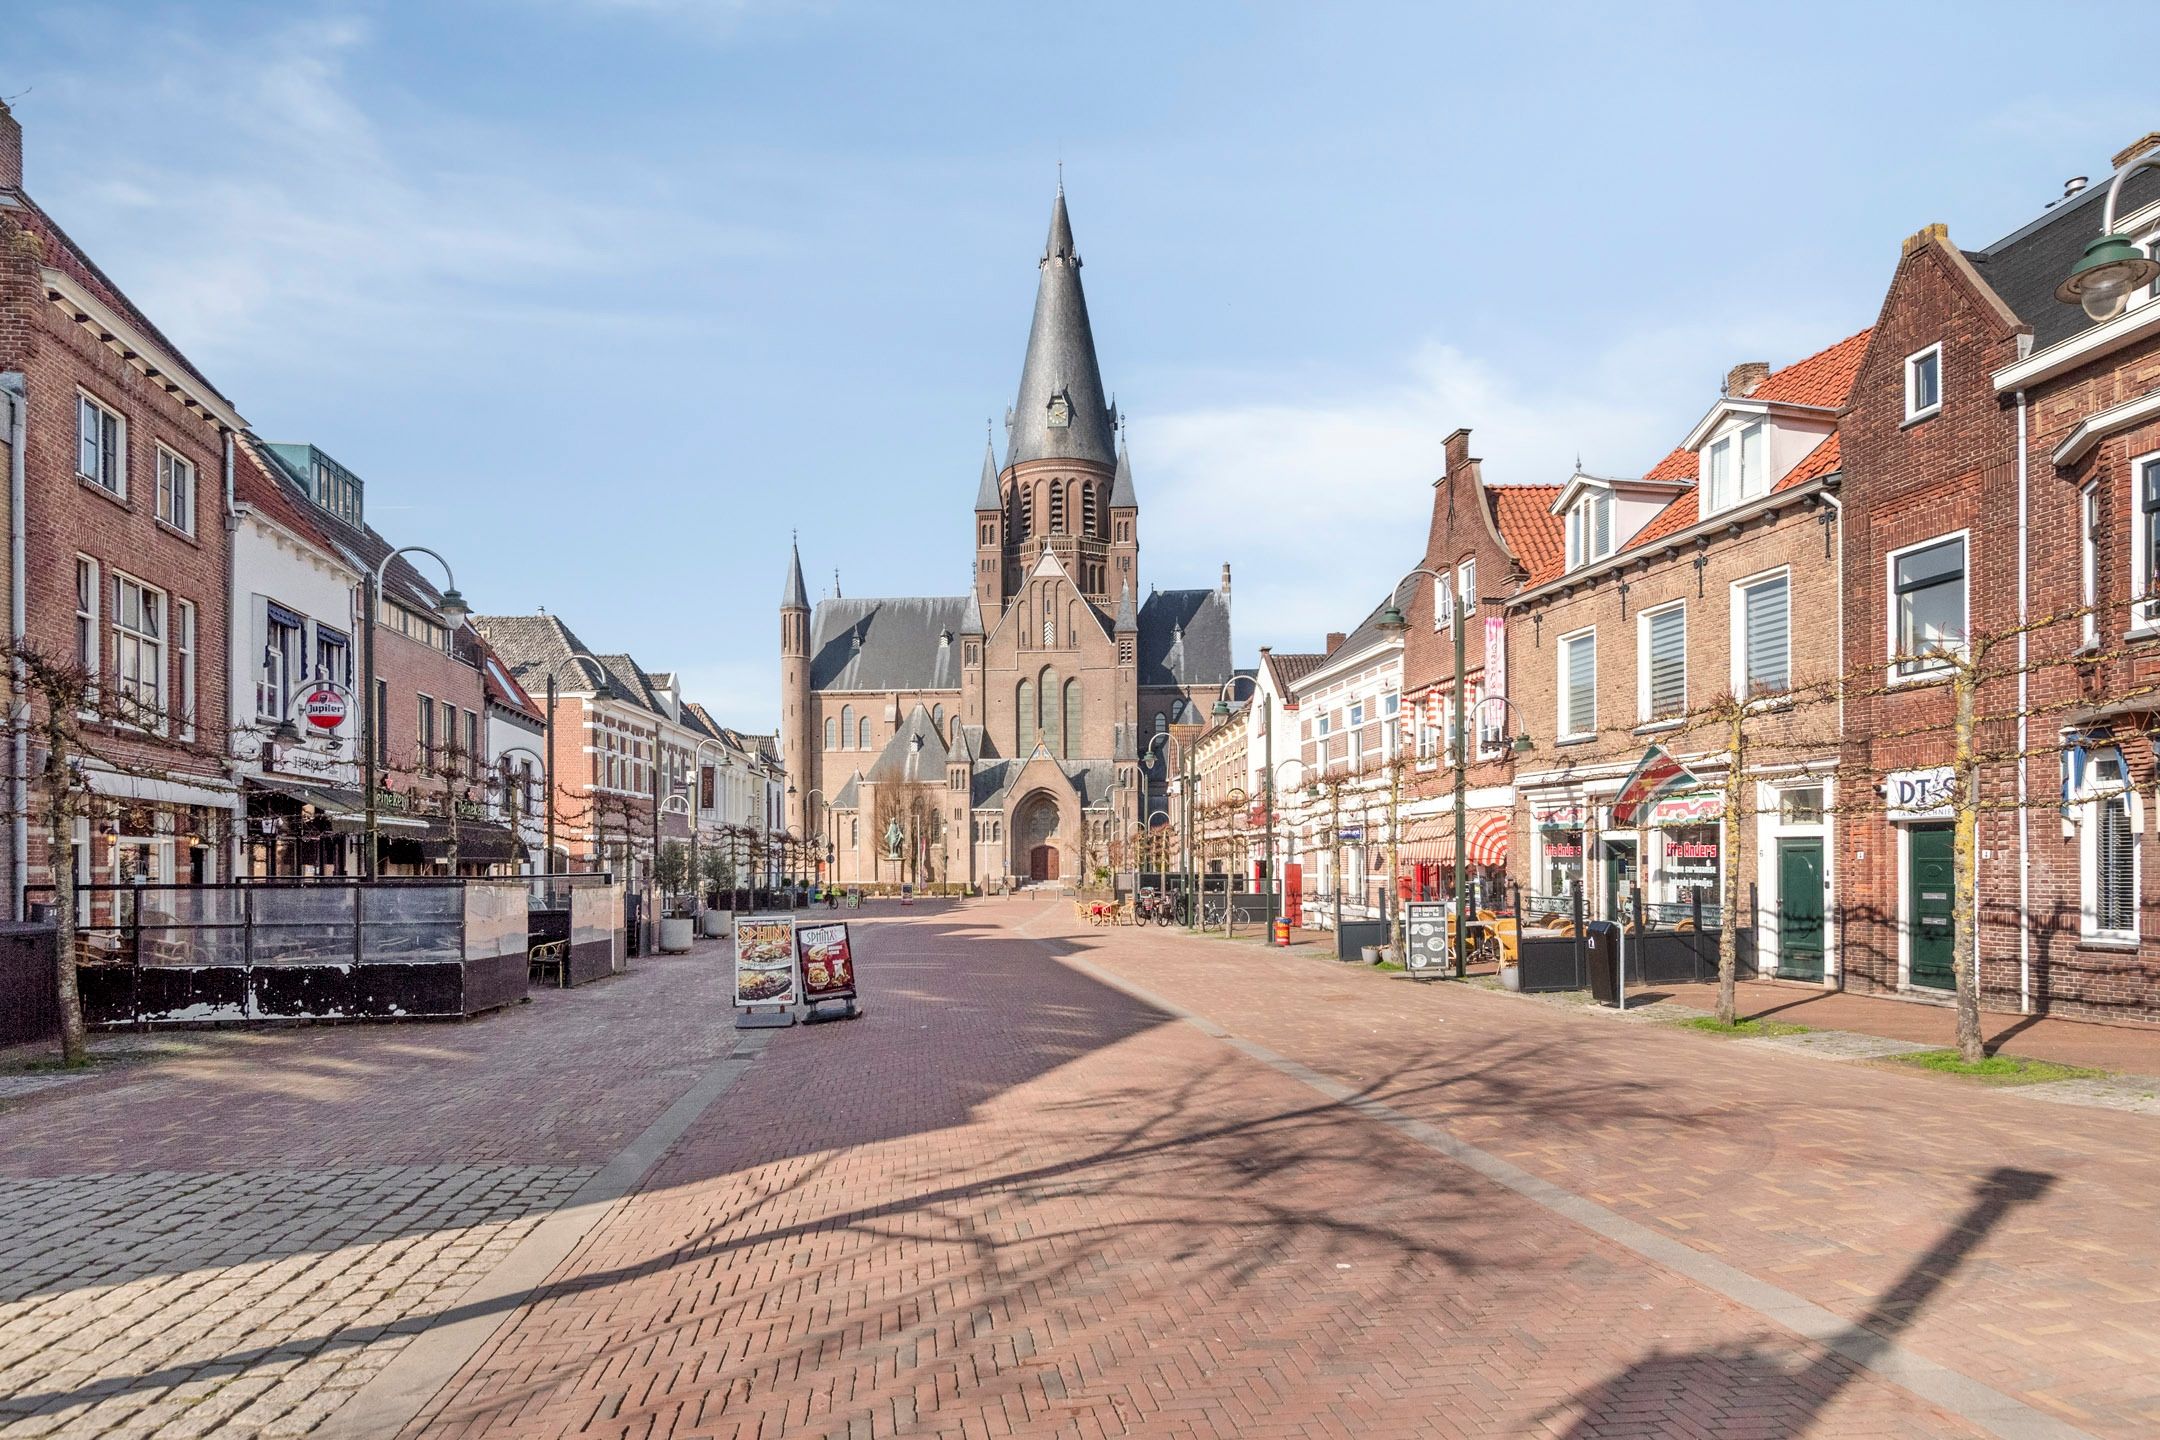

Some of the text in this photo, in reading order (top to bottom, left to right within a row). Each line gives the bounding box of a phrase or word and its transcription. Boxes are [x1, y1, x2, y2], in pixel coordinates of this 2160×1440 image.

[308, 703, 344, 714] Jupiler
[1545, 843, 1582, 857] Effe Anders
[1667, 842, 1717, 857] Effe Anders
[739, 925, 791, 943] SPHINX
[806, 929, 835, 943] SPHINX
